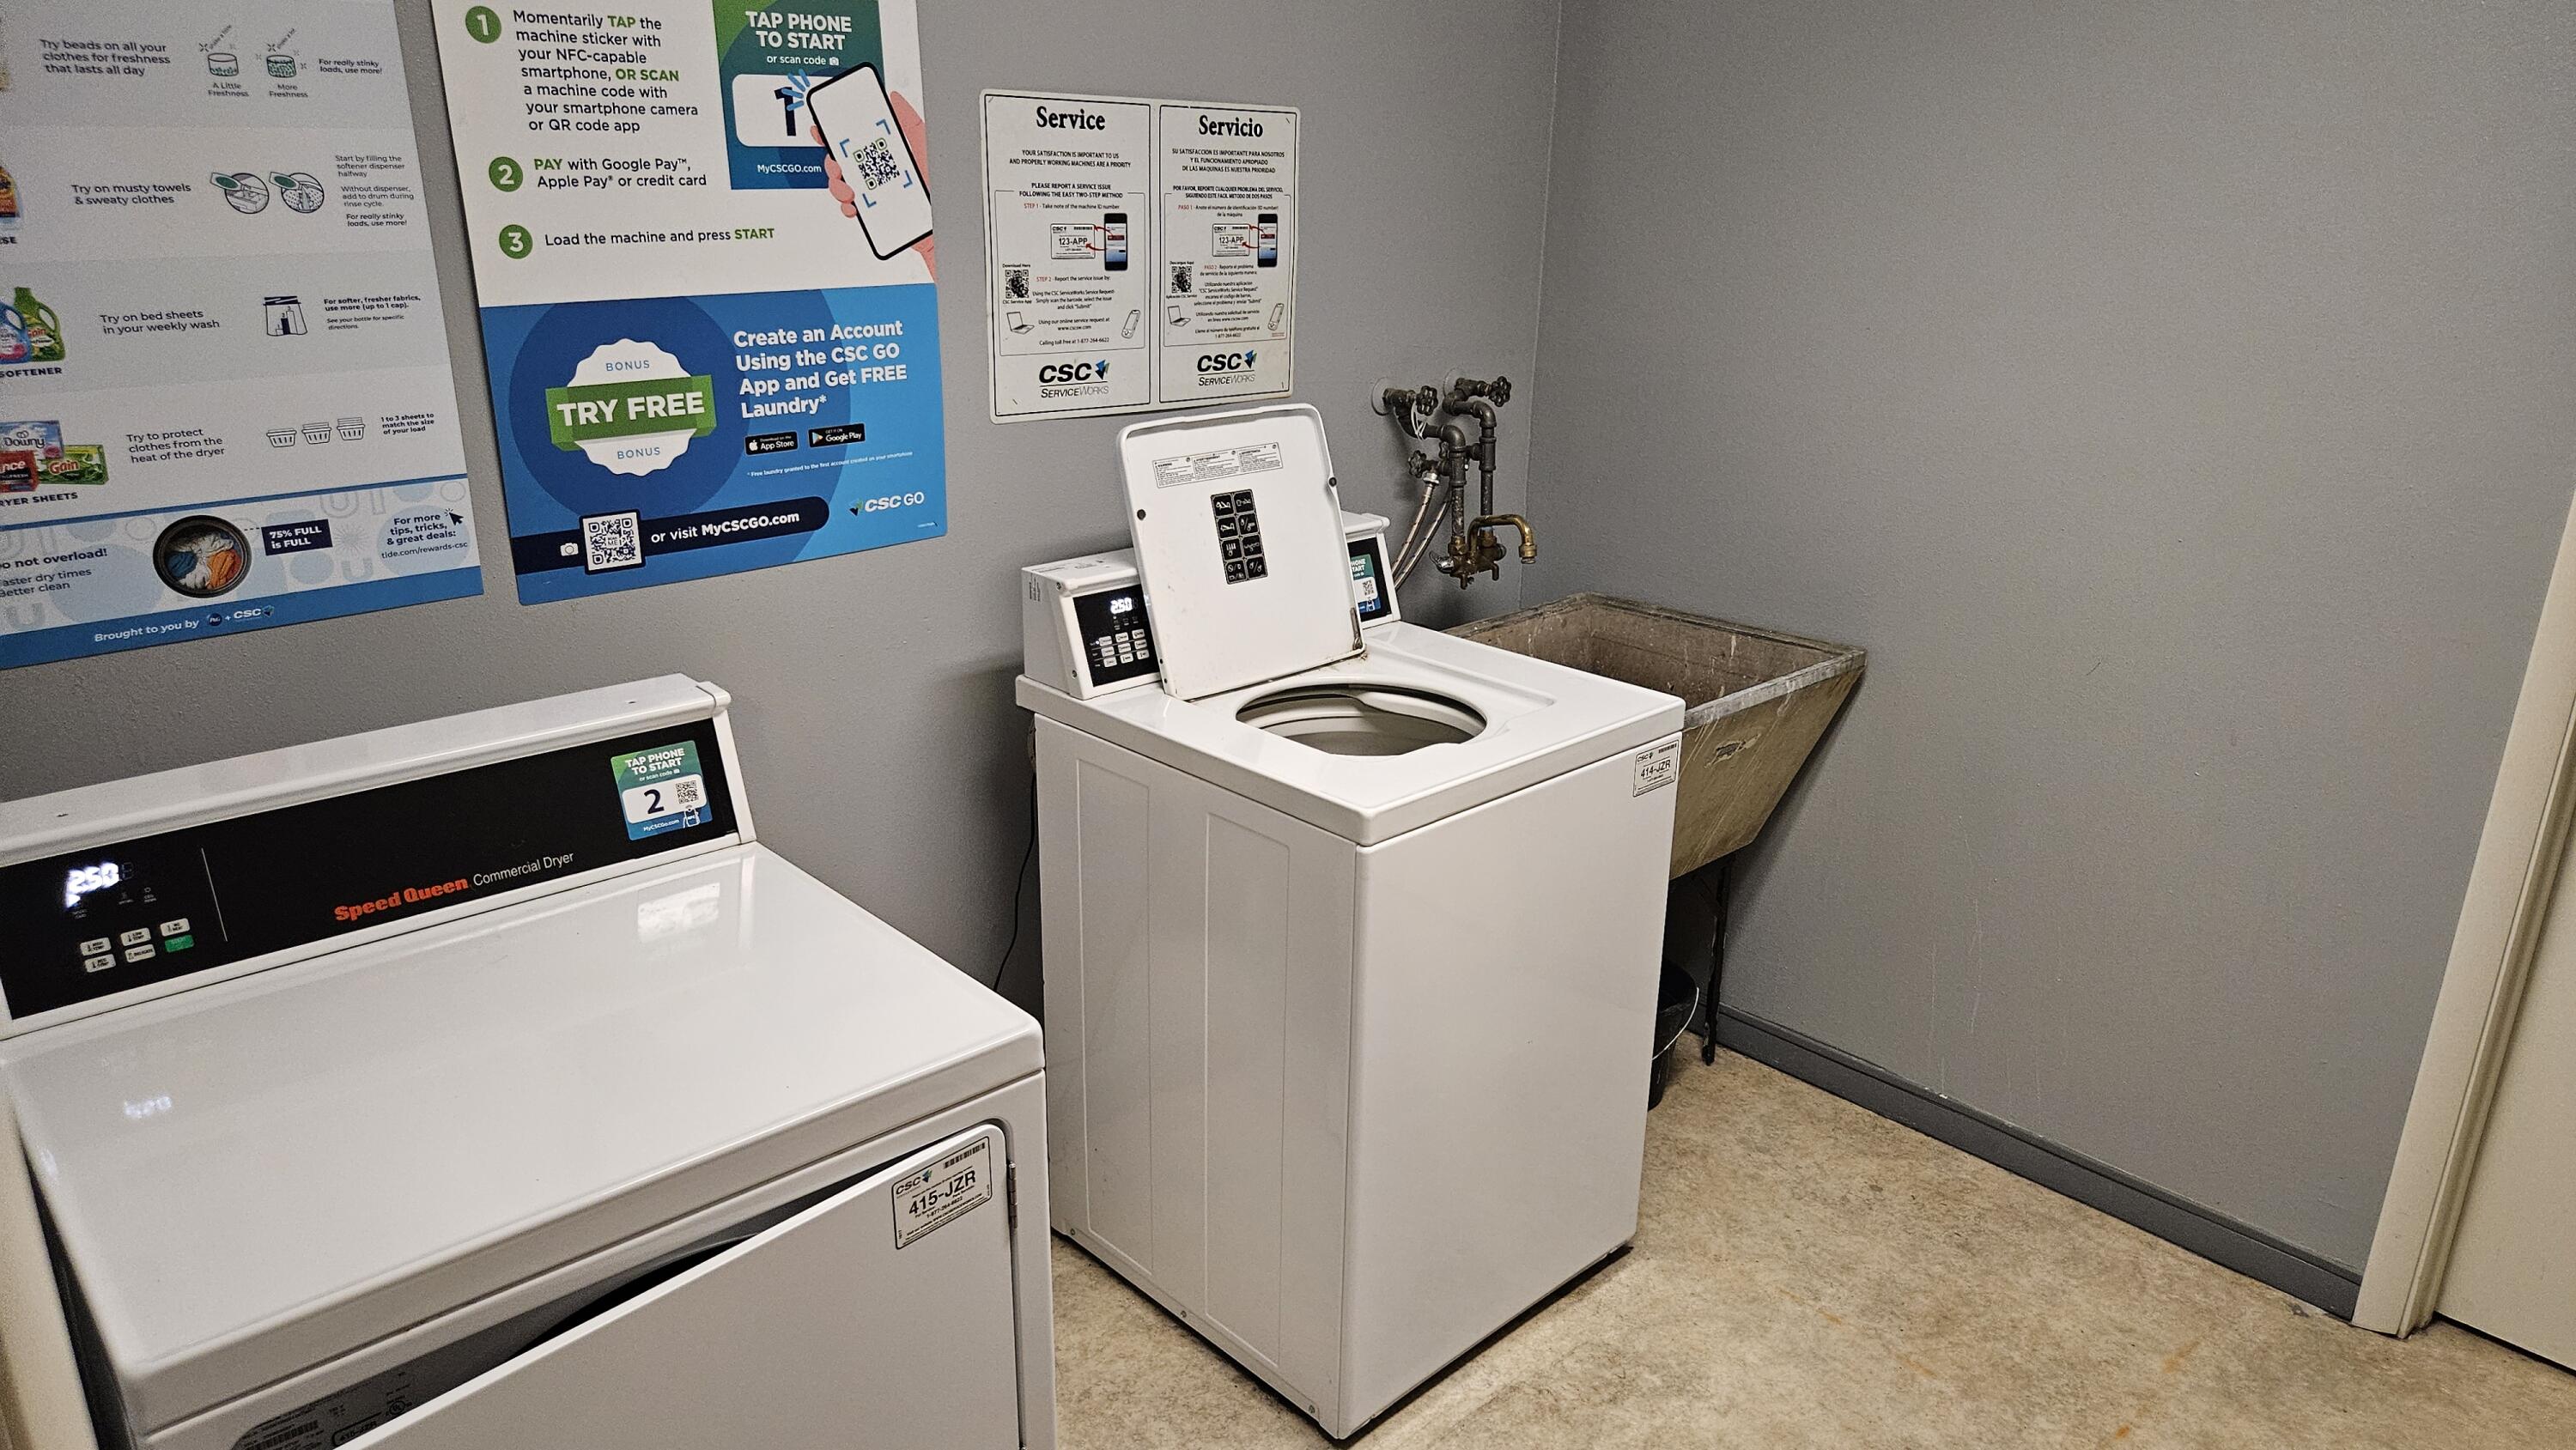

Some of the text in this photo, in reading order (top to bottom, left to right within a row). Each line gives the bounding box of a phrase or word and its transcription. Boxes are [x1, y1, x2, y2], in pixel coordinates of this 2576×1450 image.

[477, 13, 489, 35] 1
[513, 9, 661, 30] Momentarily TAP the
[744, 10, 852, 32] TAP PHONE
[515, 29, 660, 46] machine sticker with
[755, 30, 845, 50] TO START
[518, 48, 647, 64] your NFC-capable
[803, 55, 826, 64] code
[521, 66, 679, 82] smartphone, OR SCAN
[524, 83, 667, 98] a machine code with
[526, 101, 698, 116] your smartphone camera
[775, 87, 797, 137] 1
[528, 118, 640, 133] or QR code app
[1036, 106, 1105, 130] Service
[1199, 114, 1263, 137] Servicio
[533, 158, 562, 170] PAY
[567, 158, 598, 170] with
[602, 157, 650, 172] Google
[757, 163, 822, 173] MyCSCGO.com
[499, 165, 514, 185] 2
[537, 175, 579, 190] Apple
[617, 177, 631, 186] or
[636, 174, 674, 186] credit
[678, 173, 706, 185] card
[71, 185, 90, 195] Try
[112, 185, 149, 194] musty
[152, 183, 191, 191] towels
[75, 194, 174, 206] & sweaty clothes
[508, 233, 524, 252] 3
[544, 228, 775, 246] Load the machine and press START
[1058, 237, 1088, 246] 123-APP
[1218, 236, 1244, 245] 123-APP
[100, 314, 119, 325] Try
[140, 311, 163, 320] bed
[165, 310, 204, 319] sheets
[102, 319, 220, 335] in your weekly wash
[733, 320, 902, 347] Create an Account
[736, 343, 899, 371] Using the CSC GO
[1196, 353, 1242, 373] CSC
[0, 367, 63, 378] SOFTENER
[605, 360, 650, 371] BONUS
[1039, 362, 1092, 384] CSC
[739, 364, 907, 397] App and Get FREE
[557, 391, 705, 426] TRY FREE
[4, 437, 46, 449] Downy
[125, 434, 144, 443] Try
[161, 428, 204, 440] protect
[825, 433, 848, 442] Google
[128, 442, 171, 452] clothes
[172, 440, 201, 448] from
[617, 446, 660, 459] BONUS
[760, 442, 775, 451] App
[130, 448, 224, 463] heat of the dryer
[49, 460, 80, 475] Gain
[864, 491, 924, 512] CSC GO
[413, 514, 440, 523] more
[269, 525, 322, 538] 75% FULL
[390, 522, 447, 536] tips, tricks,
[651, 513, 799, 543] or visit MyCSCGO.com
[270, 537, 311, 549] is FULL
[396, 534, 423, 545] great
[426, 530, 456, 539] deals:
[381, 542, 467, 559] tide.com/rewards-csc
[625, 748, 685, 768] TAP PHONE
[631, 757, 682, 775] TO START
[1640, 760, 1671, 778] 414-JZR
[643, 788, 665, 815] 2
[334, 852, 574, 921] Speed Queen Commercial Dryer
[895, 1176, 921, 1196] CSC
[908, 1170, 976, 1215] 415-JZR
